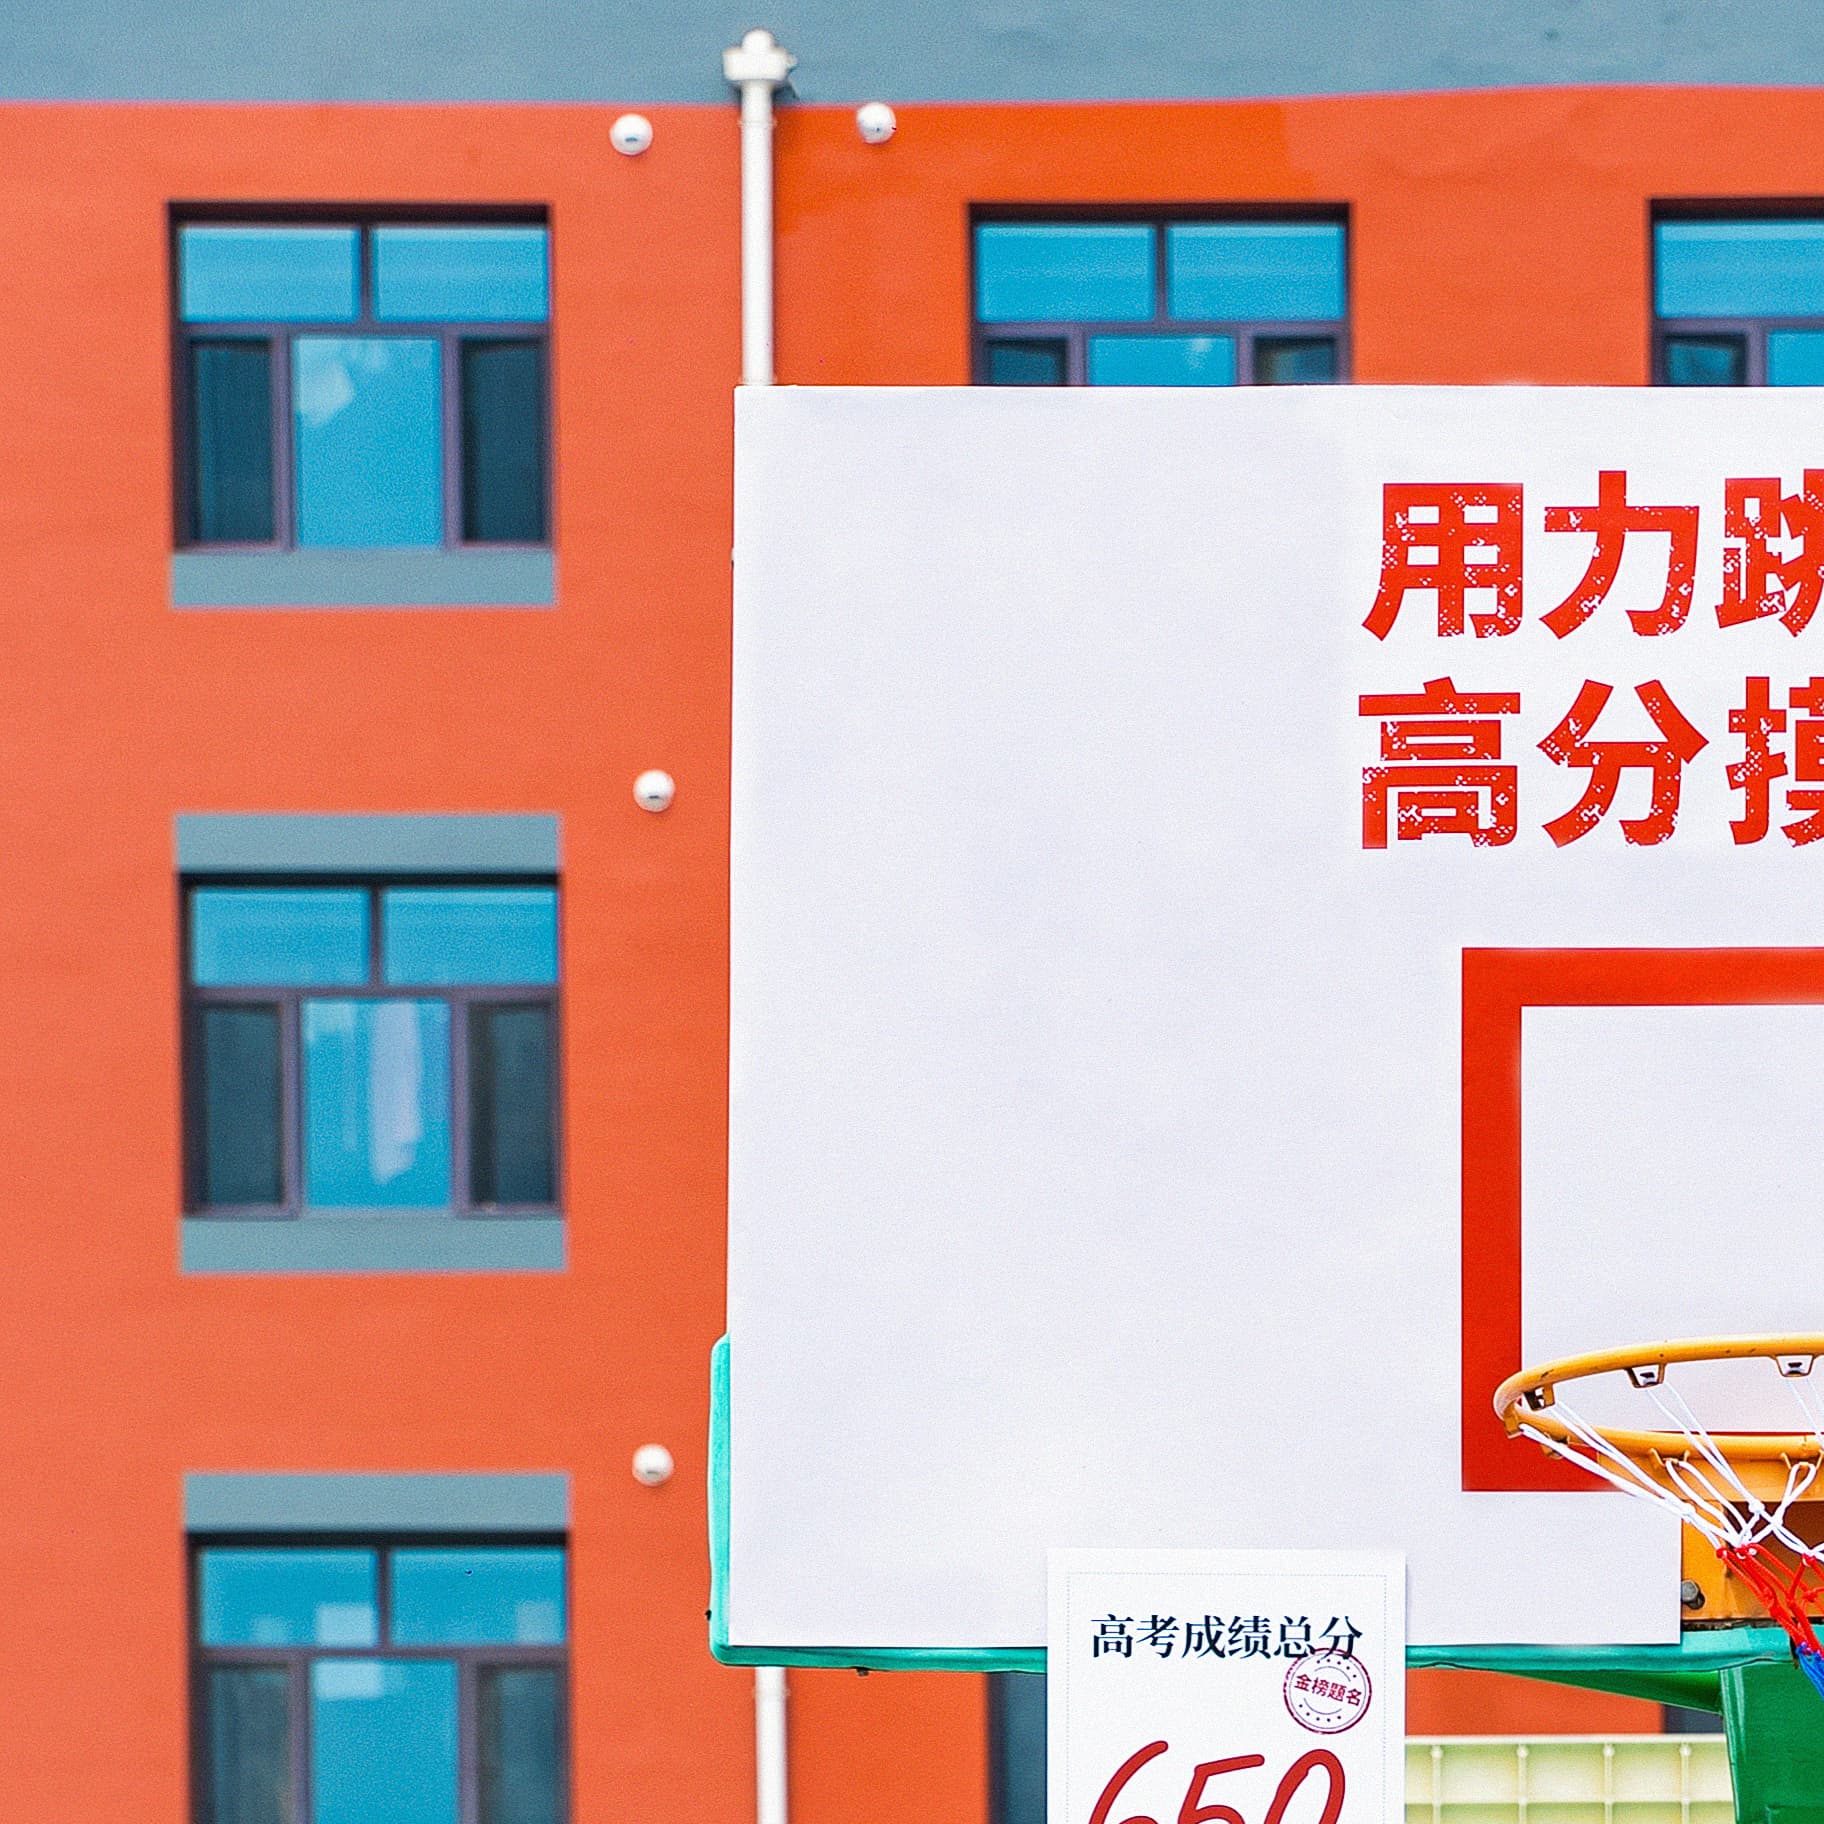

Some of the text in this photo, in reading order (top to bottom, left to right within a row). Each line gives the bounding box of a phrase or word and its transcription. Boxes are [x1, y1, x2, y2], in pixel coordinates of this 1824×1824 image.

[1091, 1614, 1364, 1660] 高考成绩总分
[1293, 1673, 1362, 1707] 金榜题名
